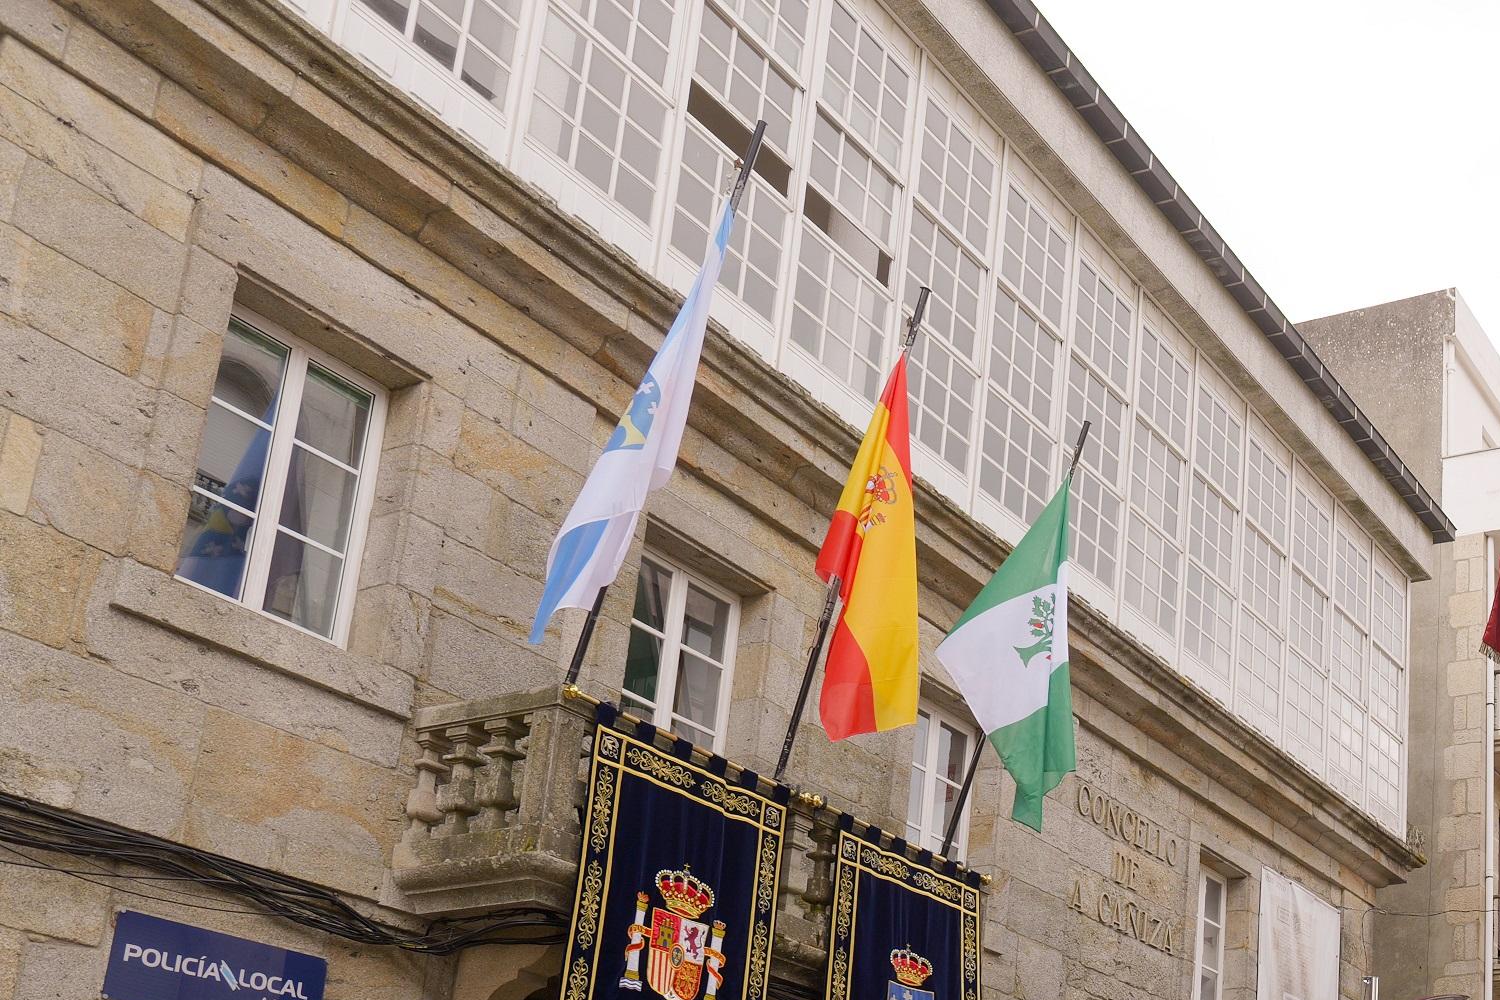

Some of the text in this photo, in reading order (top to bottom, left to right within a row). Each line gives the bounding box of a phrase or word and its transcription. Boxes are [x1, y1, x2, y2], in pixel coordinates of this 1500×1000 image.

[1077, 785, 1177, 867] CONCELLO
[1068, 879, 1083, 911] A
[1113, 851, 1139, 891] DE
[123, 943, 308, 1000] POLICÍA LOCAL
